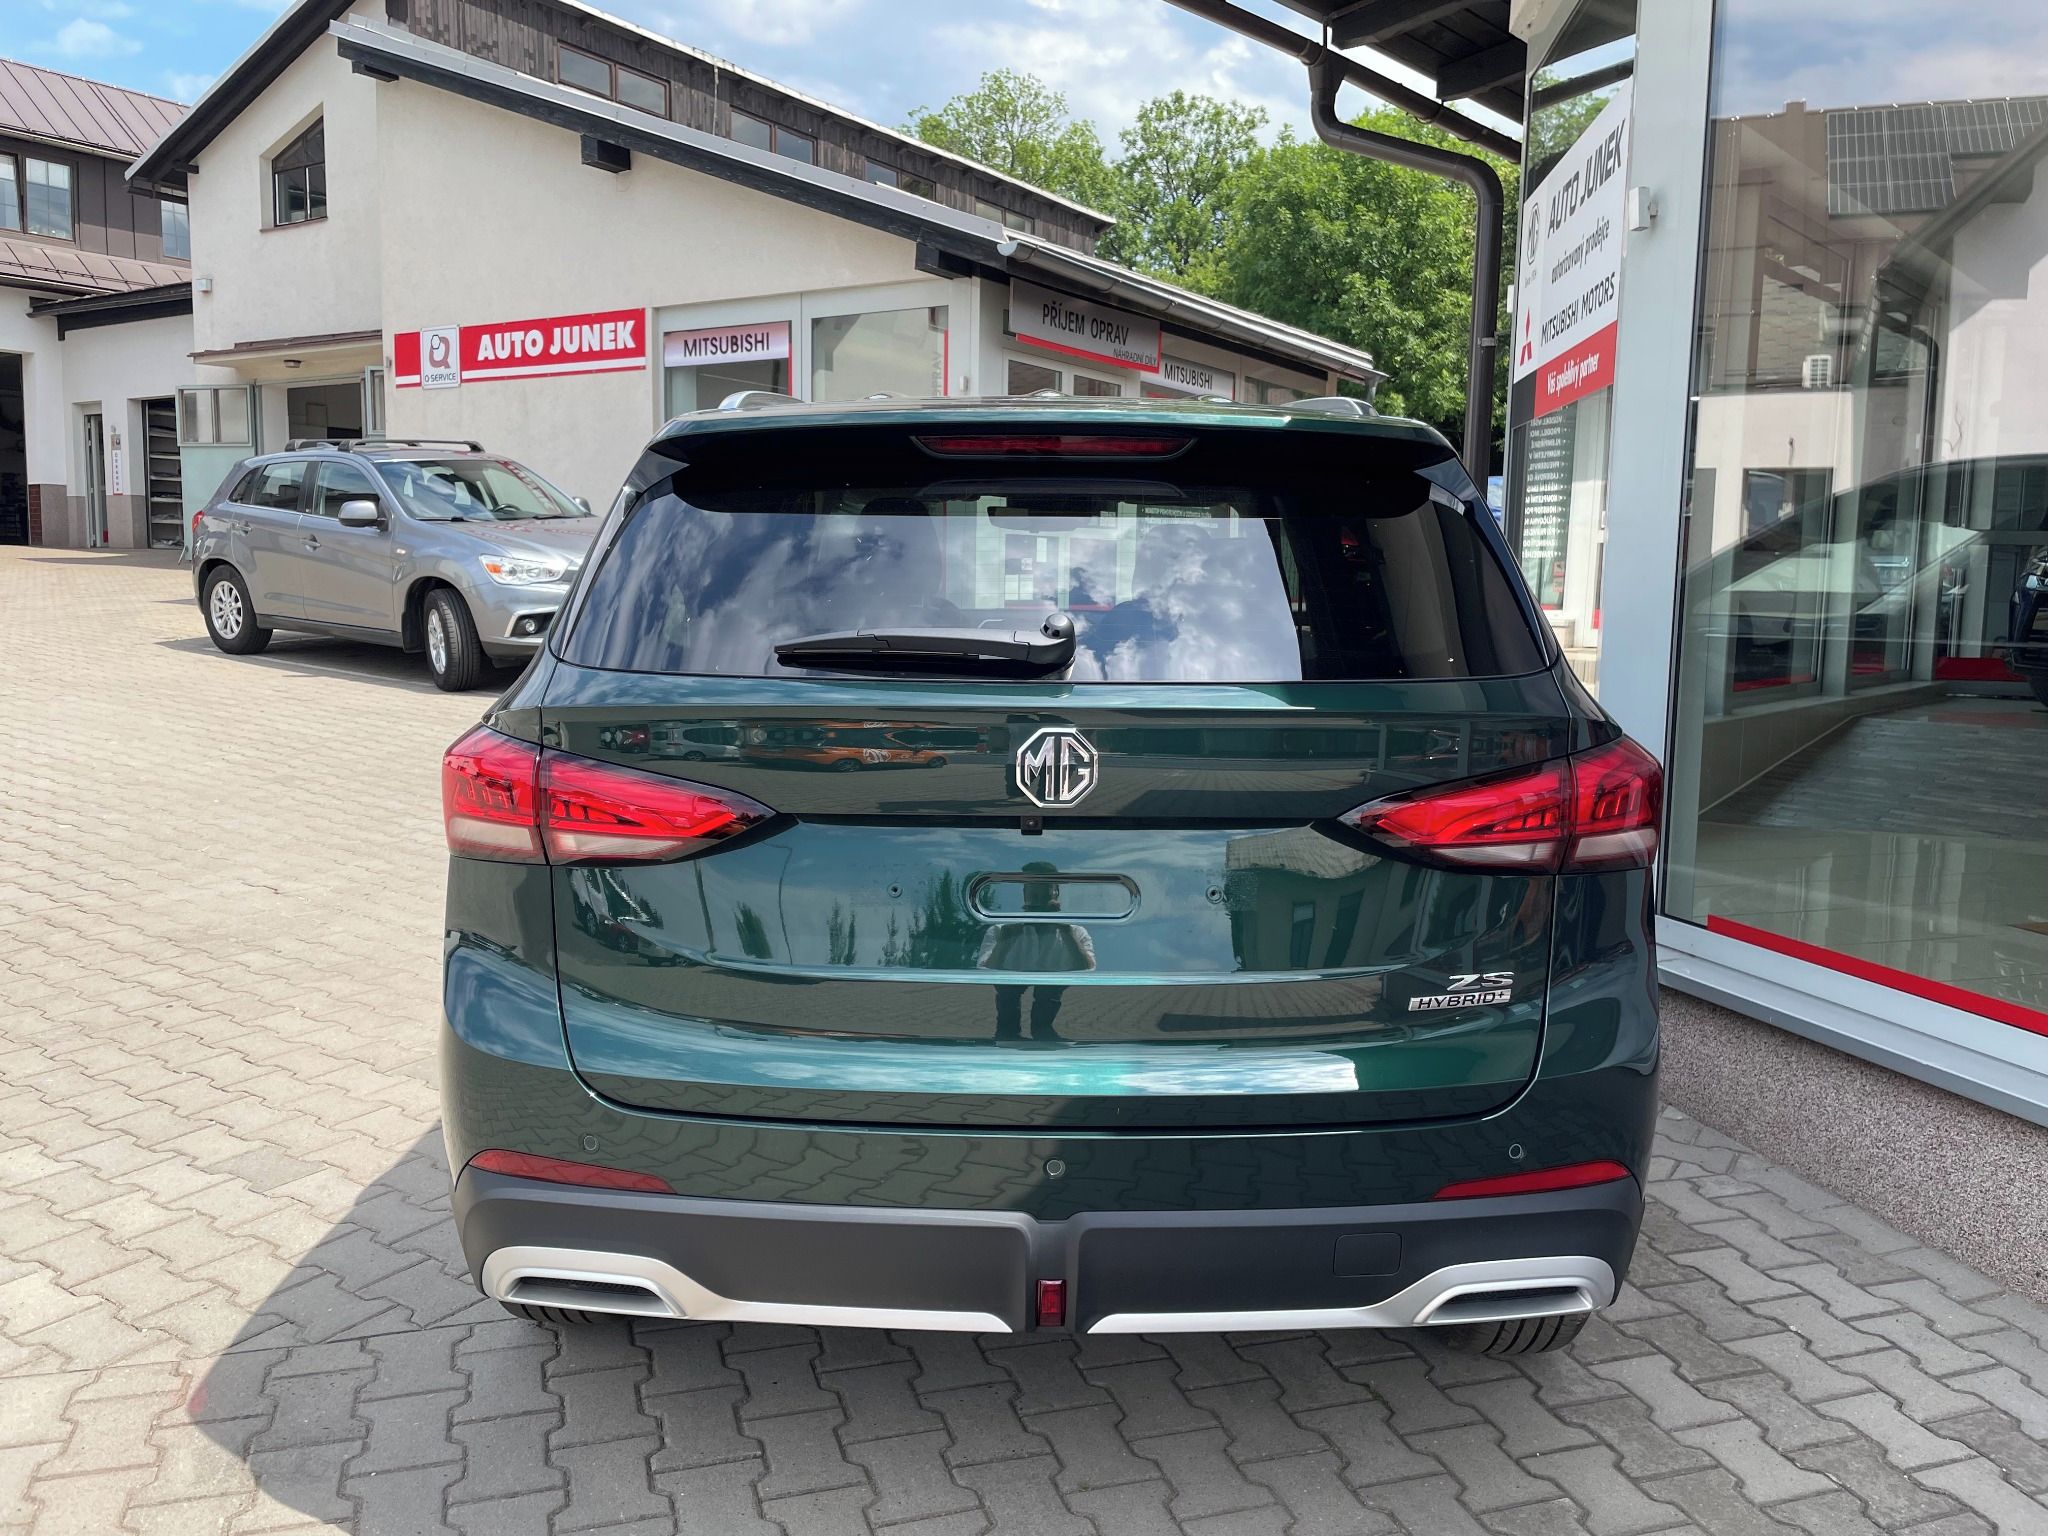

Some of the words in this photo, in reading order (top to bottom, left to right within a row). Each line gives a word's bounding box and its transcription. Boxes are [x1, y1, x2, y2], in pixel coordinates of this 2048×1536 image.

[1547, 170, 1580, 239] AUTO
[1580, 118, 1626, 208] JUNEK
[1551, 233, 1585, 284] autorizovaný
[1584, 216, 1610, 265] prodejce
[1042, 300, 1085, 336] PŘÍJEM
[1090, 318, 1129, 346] OPRAV
[1541, 299, 1579, 347] MITSUBISHI
[1581, 271, 1616, 319] MOTORS
[477, 329, 544, 362] AUTO
[550, 320, 636, 355] JUNEK
[683, 331, 770, 358] MITSUBISHI
[430, 372, 457, 383] SERVICE
[1164, 362, 1213, 390] MITSUBISHI
[1556, 359, 1579, 397] spolehlivý
[1579, 352, 1600, 387] partner
[1023, 734, 1092, 802] MG
[1417, 991, 1505, 1009] HYBRID+
[1446, 971, 1515, 991] ZS
